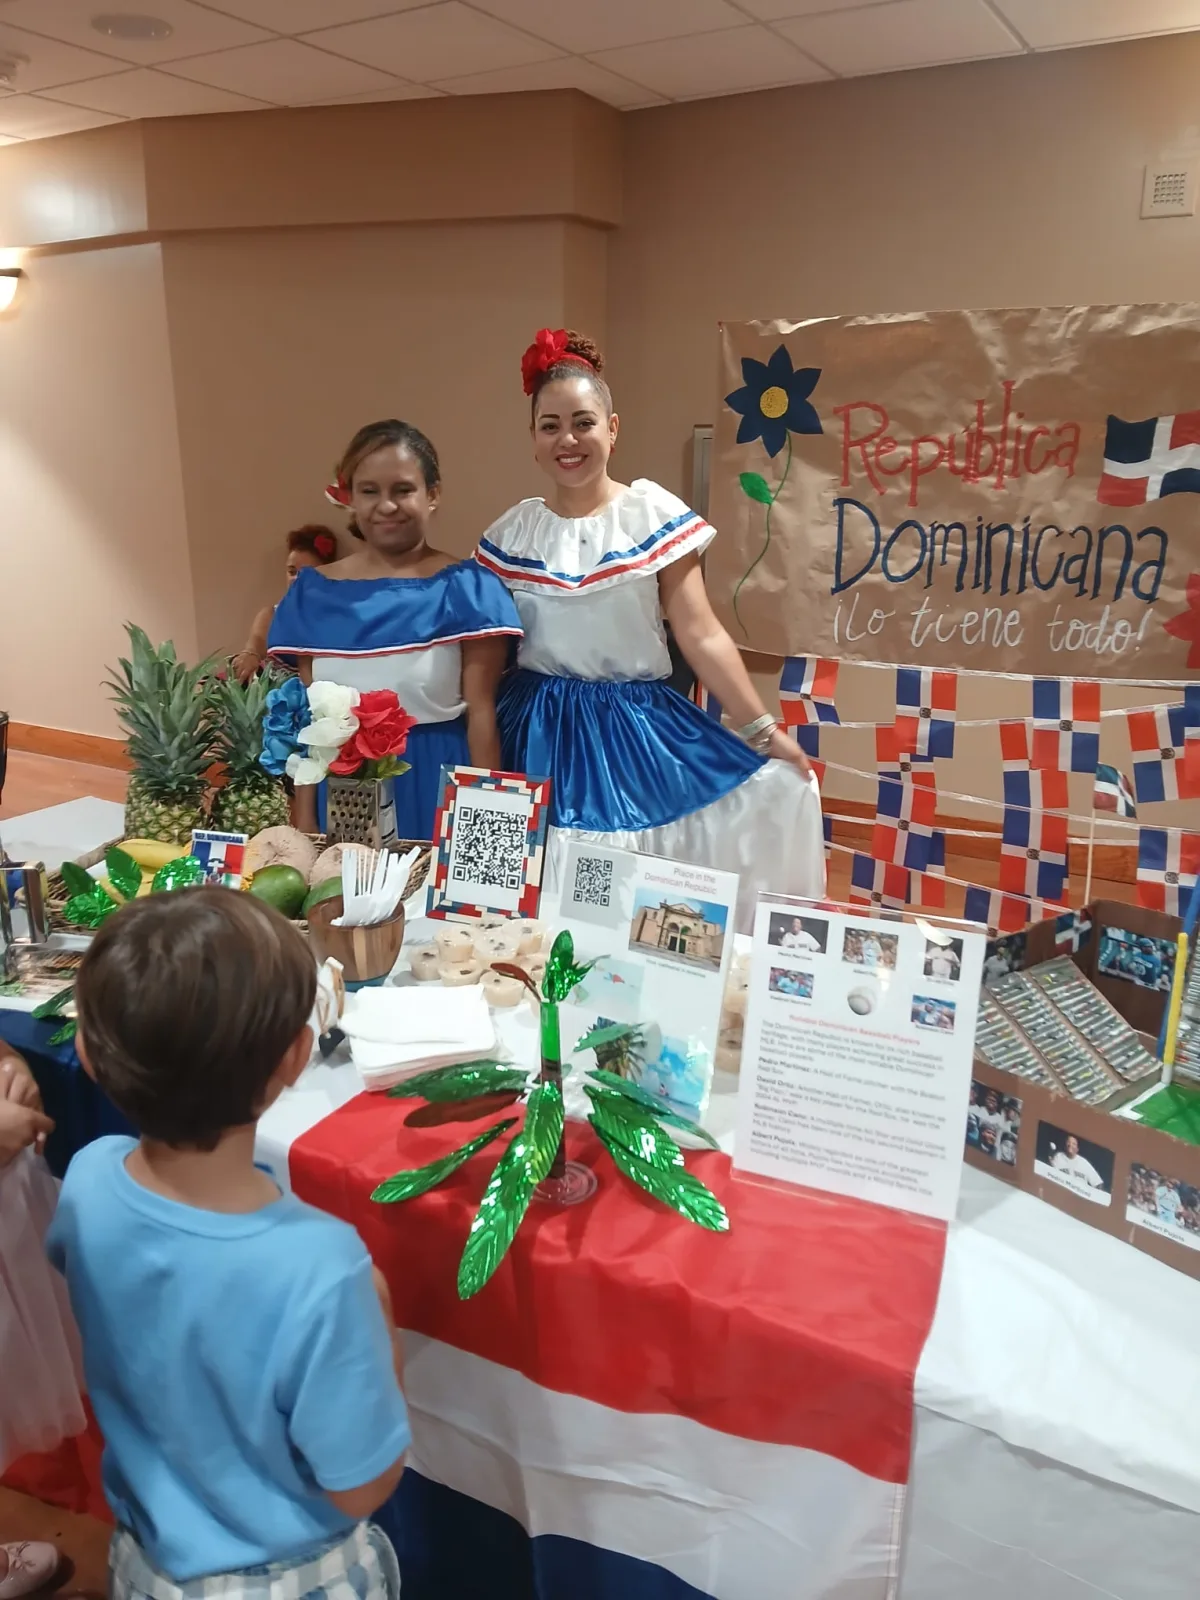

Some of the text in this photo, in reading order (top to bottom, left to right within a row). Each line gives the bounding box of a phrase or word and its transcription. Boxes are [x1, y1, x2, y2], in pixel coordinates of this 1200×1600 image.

[831, 498, 1168, 604] Dominicana
[911, 597, 1025, 648] tiene
[1047, 604, 1154, 653] todo!
[644, 872, 717, 895] Dominican Republic
[674, 867, 694, 879] Place
[703, 874, 716, 884] the
